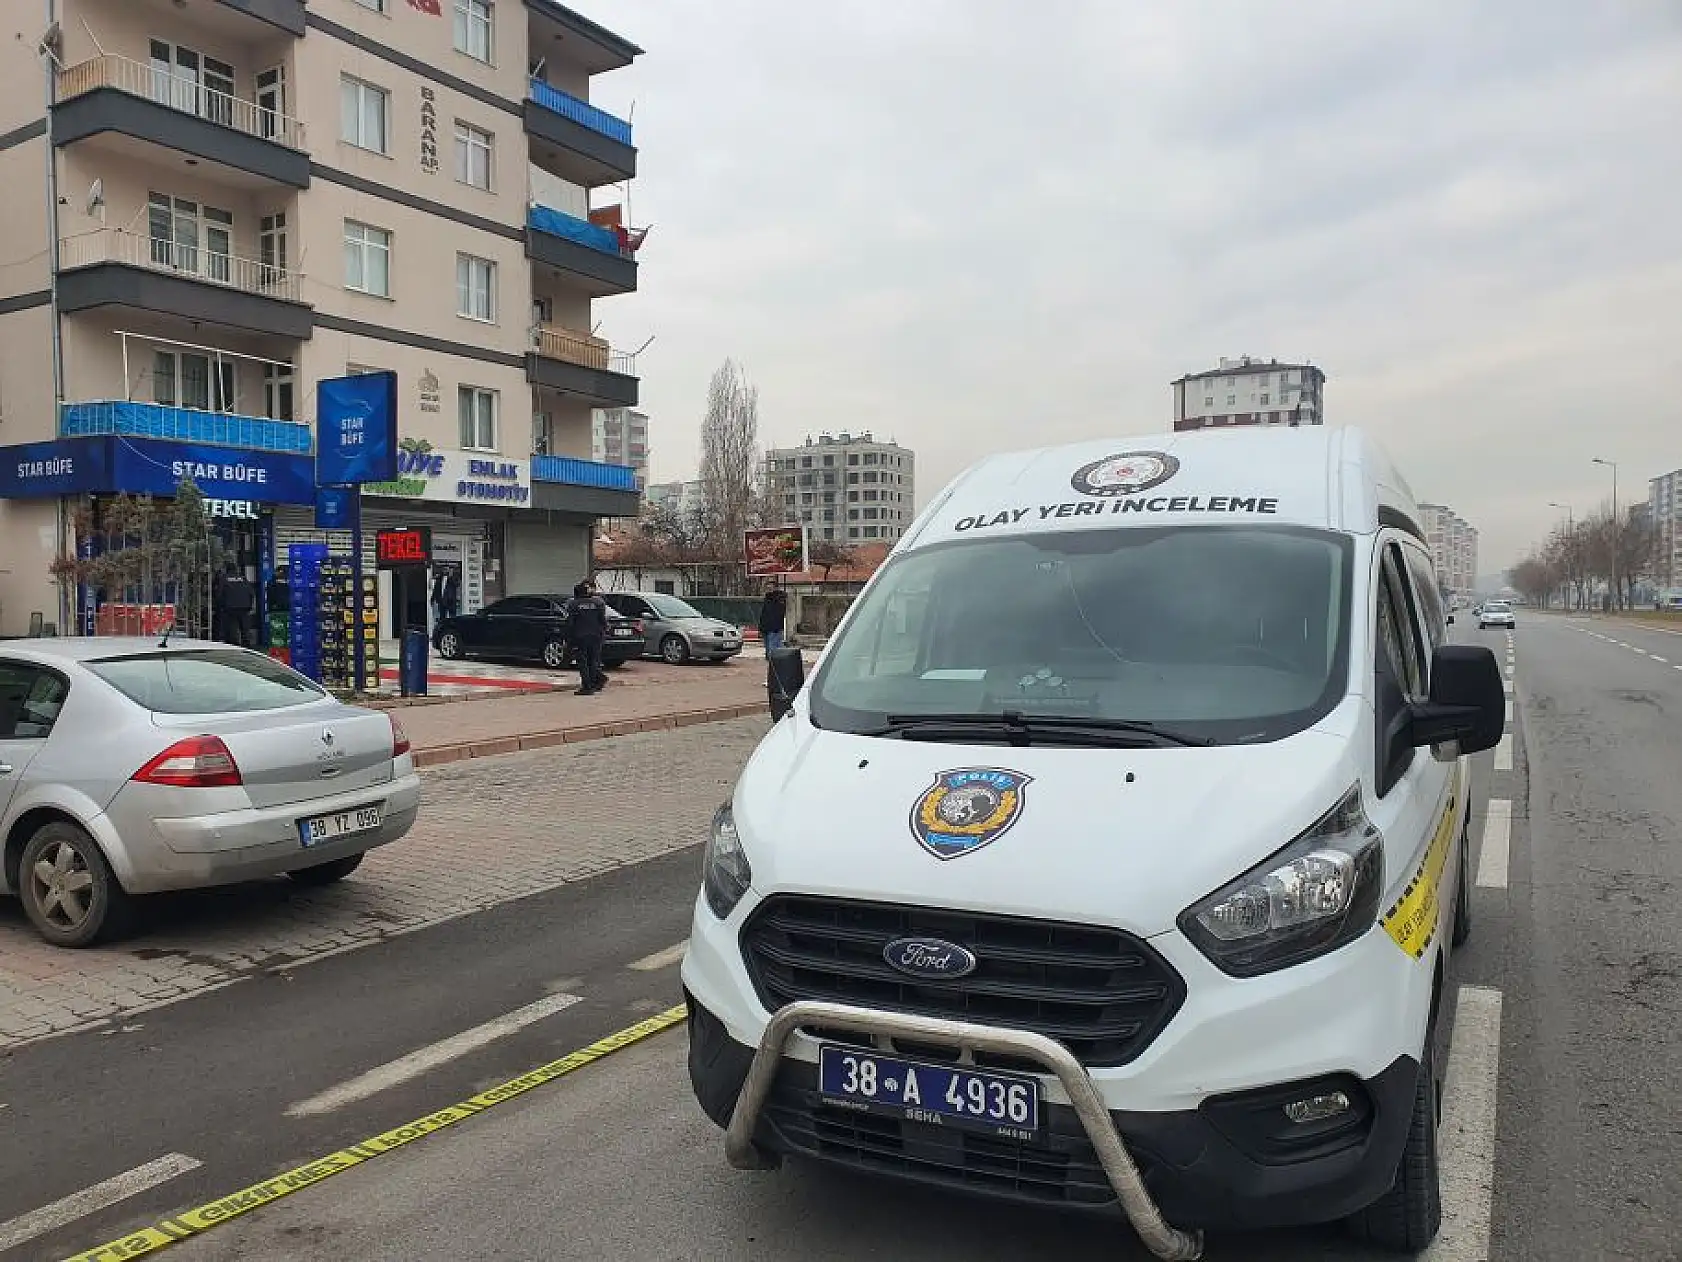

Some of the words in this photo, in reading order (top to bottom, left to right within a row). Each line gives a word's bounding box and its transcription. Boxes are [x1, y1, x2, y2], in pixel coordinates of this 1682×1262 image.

[420, 86, 437, 156] BARAN
[341, 417, 364, 430] STAR
[18, 461, 43, 478] STAR
[45, 456, 74, 476] BÜFE
[172, 461, 218, 479] STAR
[222, 463, 267, 483] BÜFE
[468, 459, 518, 479] EMLAK
[201, 498, 260, 520] TEKEL
[954, 507, 1031, 533] OLAY
[1038, 501, 1105, 520] YERİ
[1111, 496, 1279, 516] İNCELEME
[378, 532, 427, 560] TEKEL
[310, 819, 327, 838] 38
[334, 813, 351, 833] YZ
[902, 943, 952, 969] Ford
[842, 1057, 878, 1097] 38
[902, 1067, 921, 1105] A
[945, 1073, 1029, 1123] 4936
